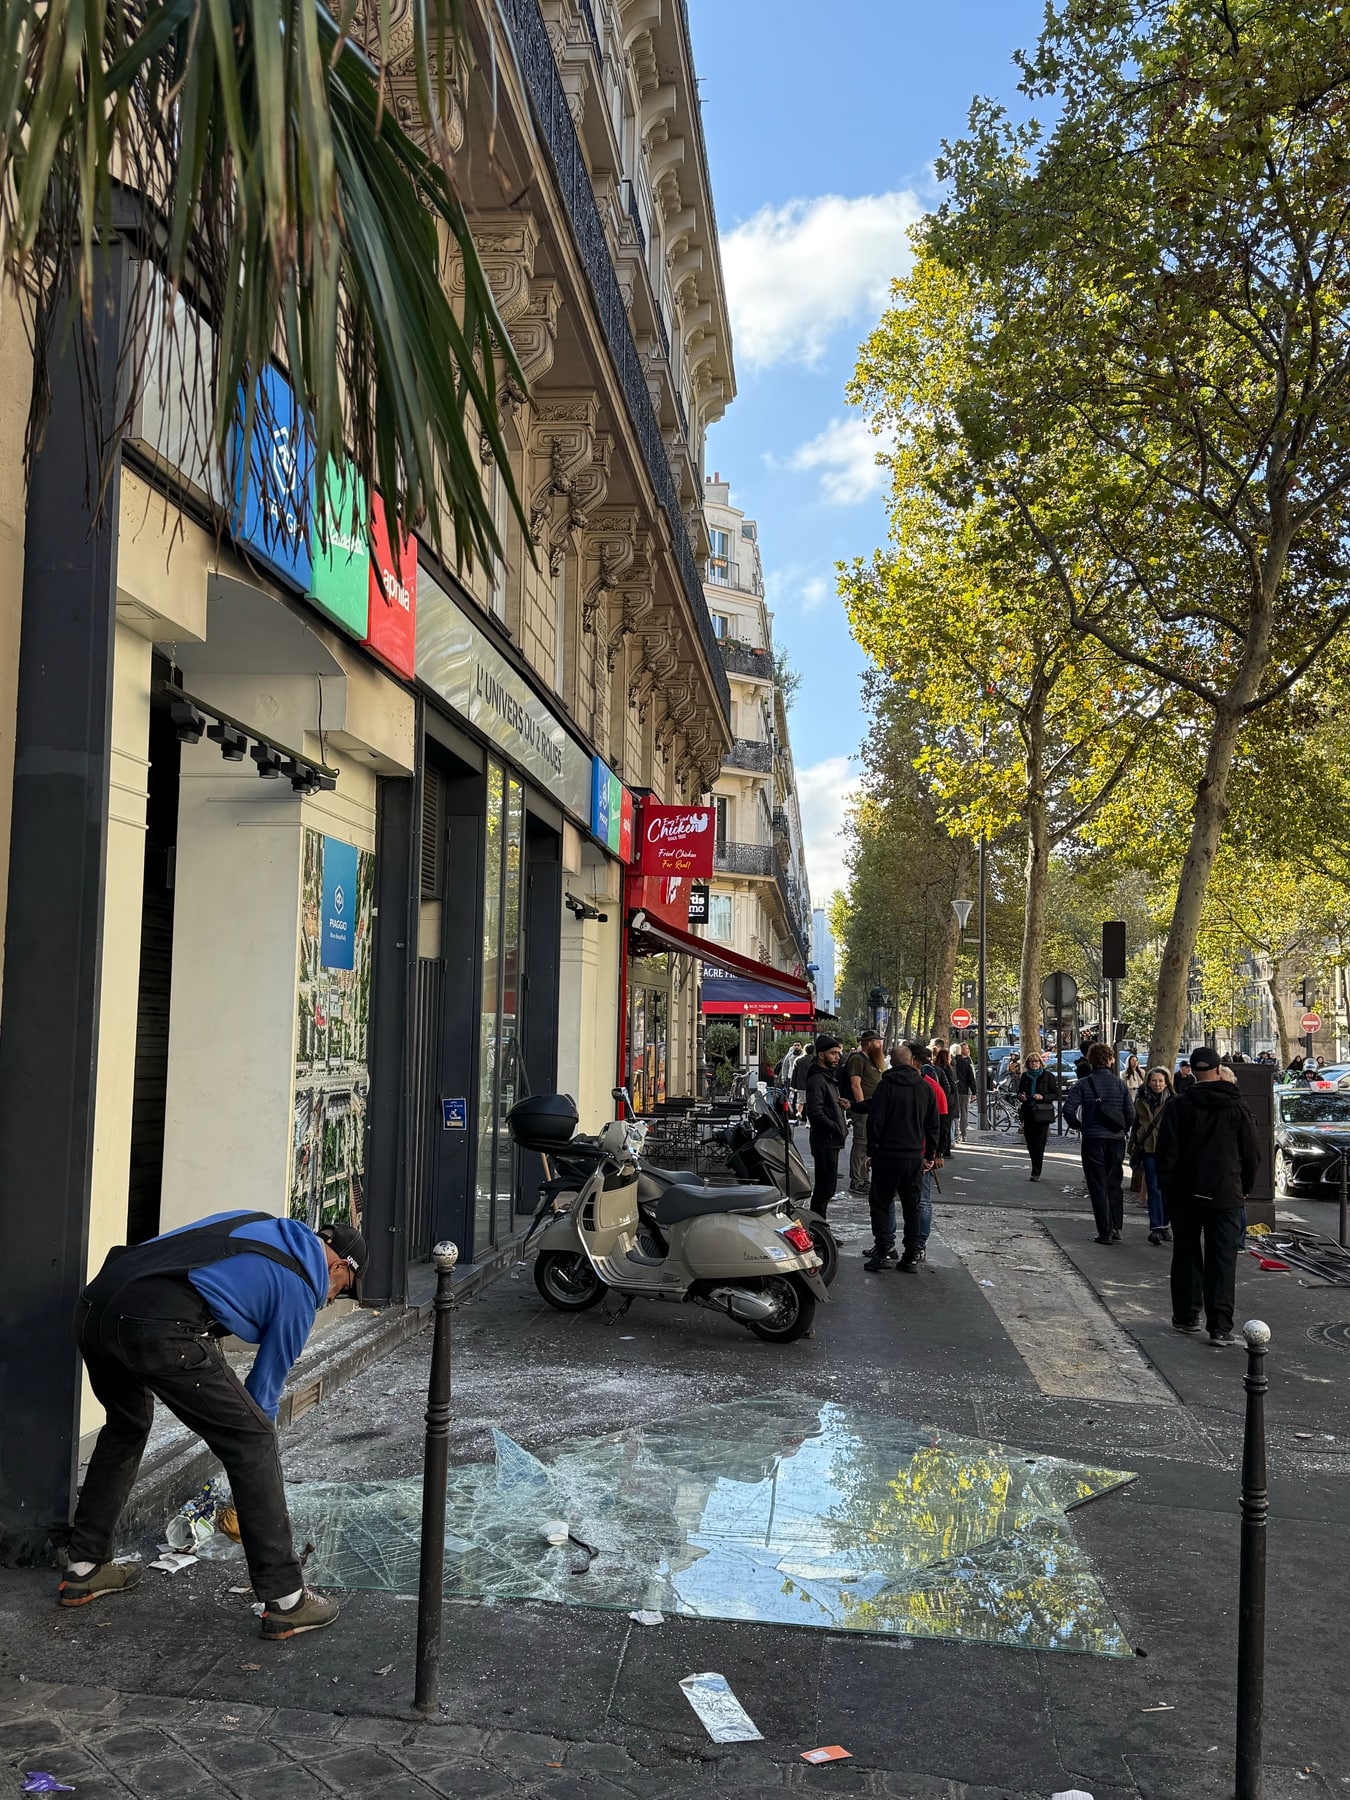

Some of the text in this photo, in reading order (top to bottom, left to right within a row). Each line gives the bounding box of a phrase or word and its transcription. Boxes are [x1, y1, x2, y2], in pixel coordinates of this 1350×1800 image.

[524, 712, 535, 746] DU
[536, 725, 541, 753] 2
[541, 731, 562, 774] ROUES
[647, 817, 698, 843] Chicken
[658, 848, 697, 859] Fried Chicken
[662, 859, 673, 868] For
[703, 967, 724, 979] ACRE
